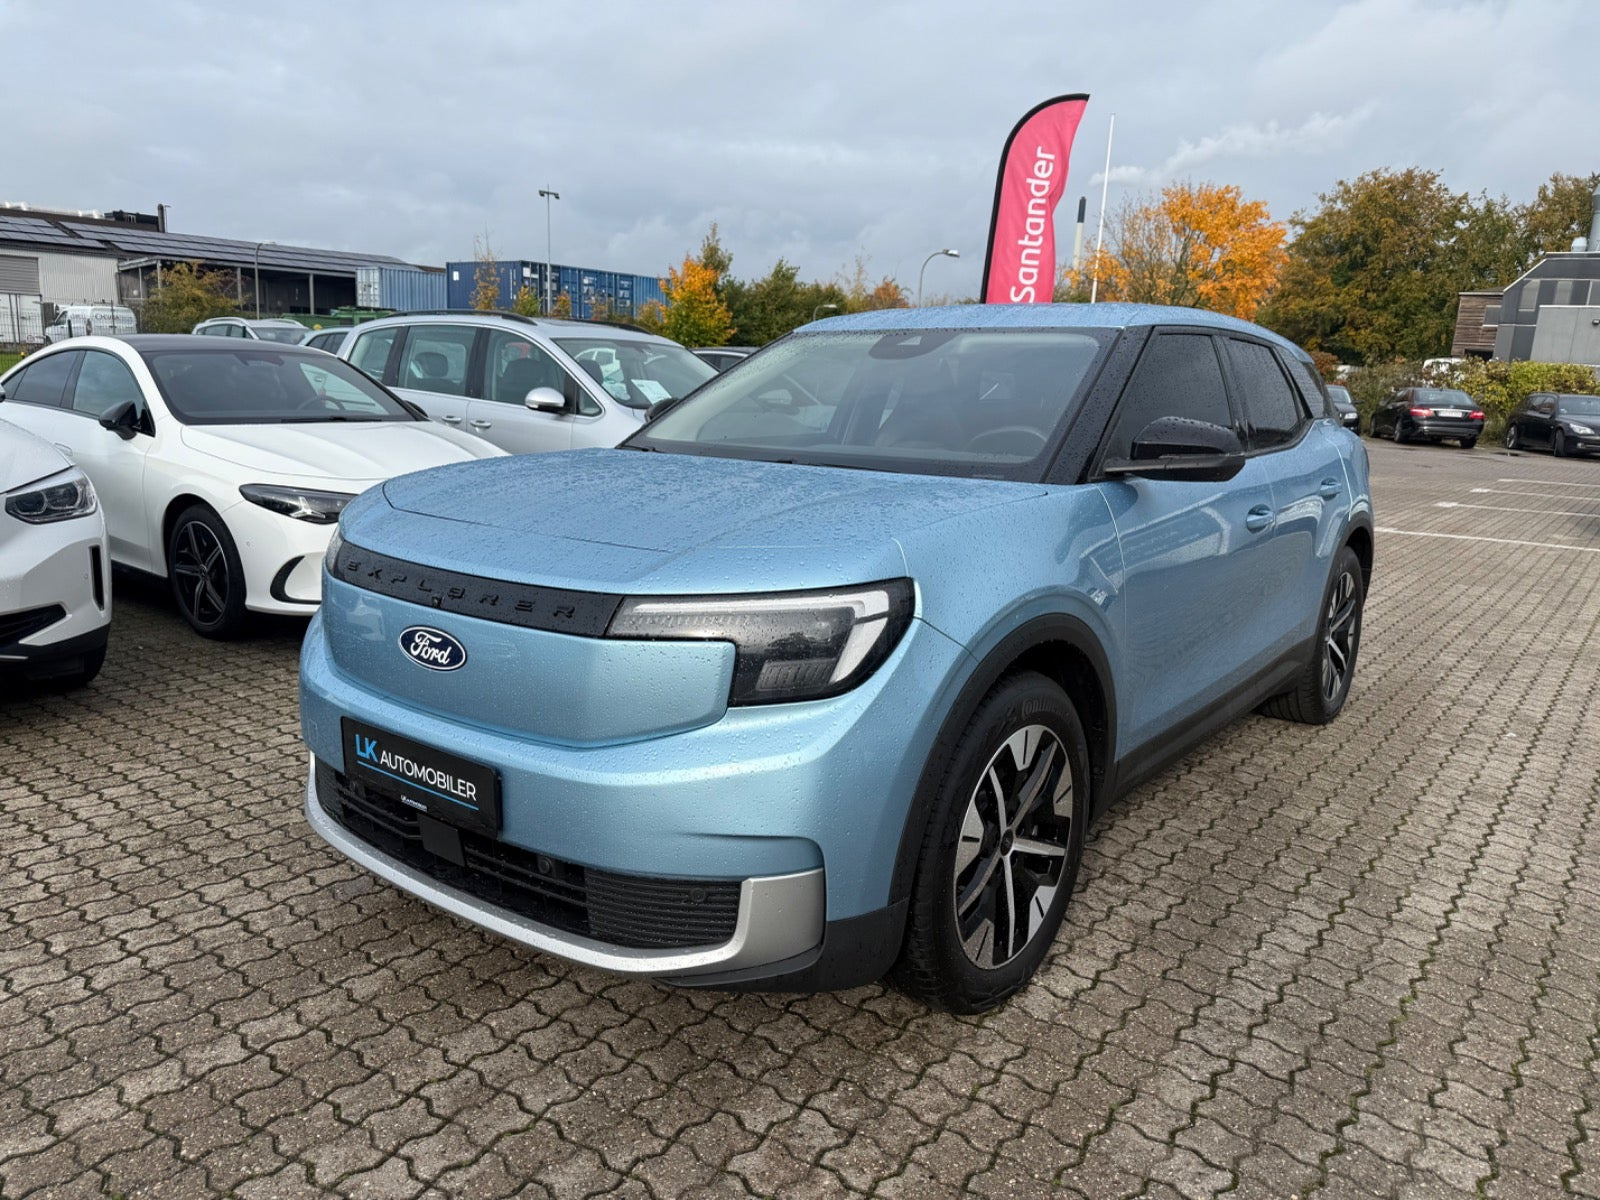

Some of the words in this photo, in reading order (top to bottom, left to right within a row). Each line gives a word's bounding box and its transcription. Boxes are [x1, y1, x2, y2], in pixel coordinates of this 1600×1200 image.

[1010, 145, 1056, 304] Santander
[347, 560, 576, 619] EXPLORER
[410, 630, 451, 665] Ford
[355, 733, 379, 763] LK
[380, 749, 478, 802] AUTOMOBILER
